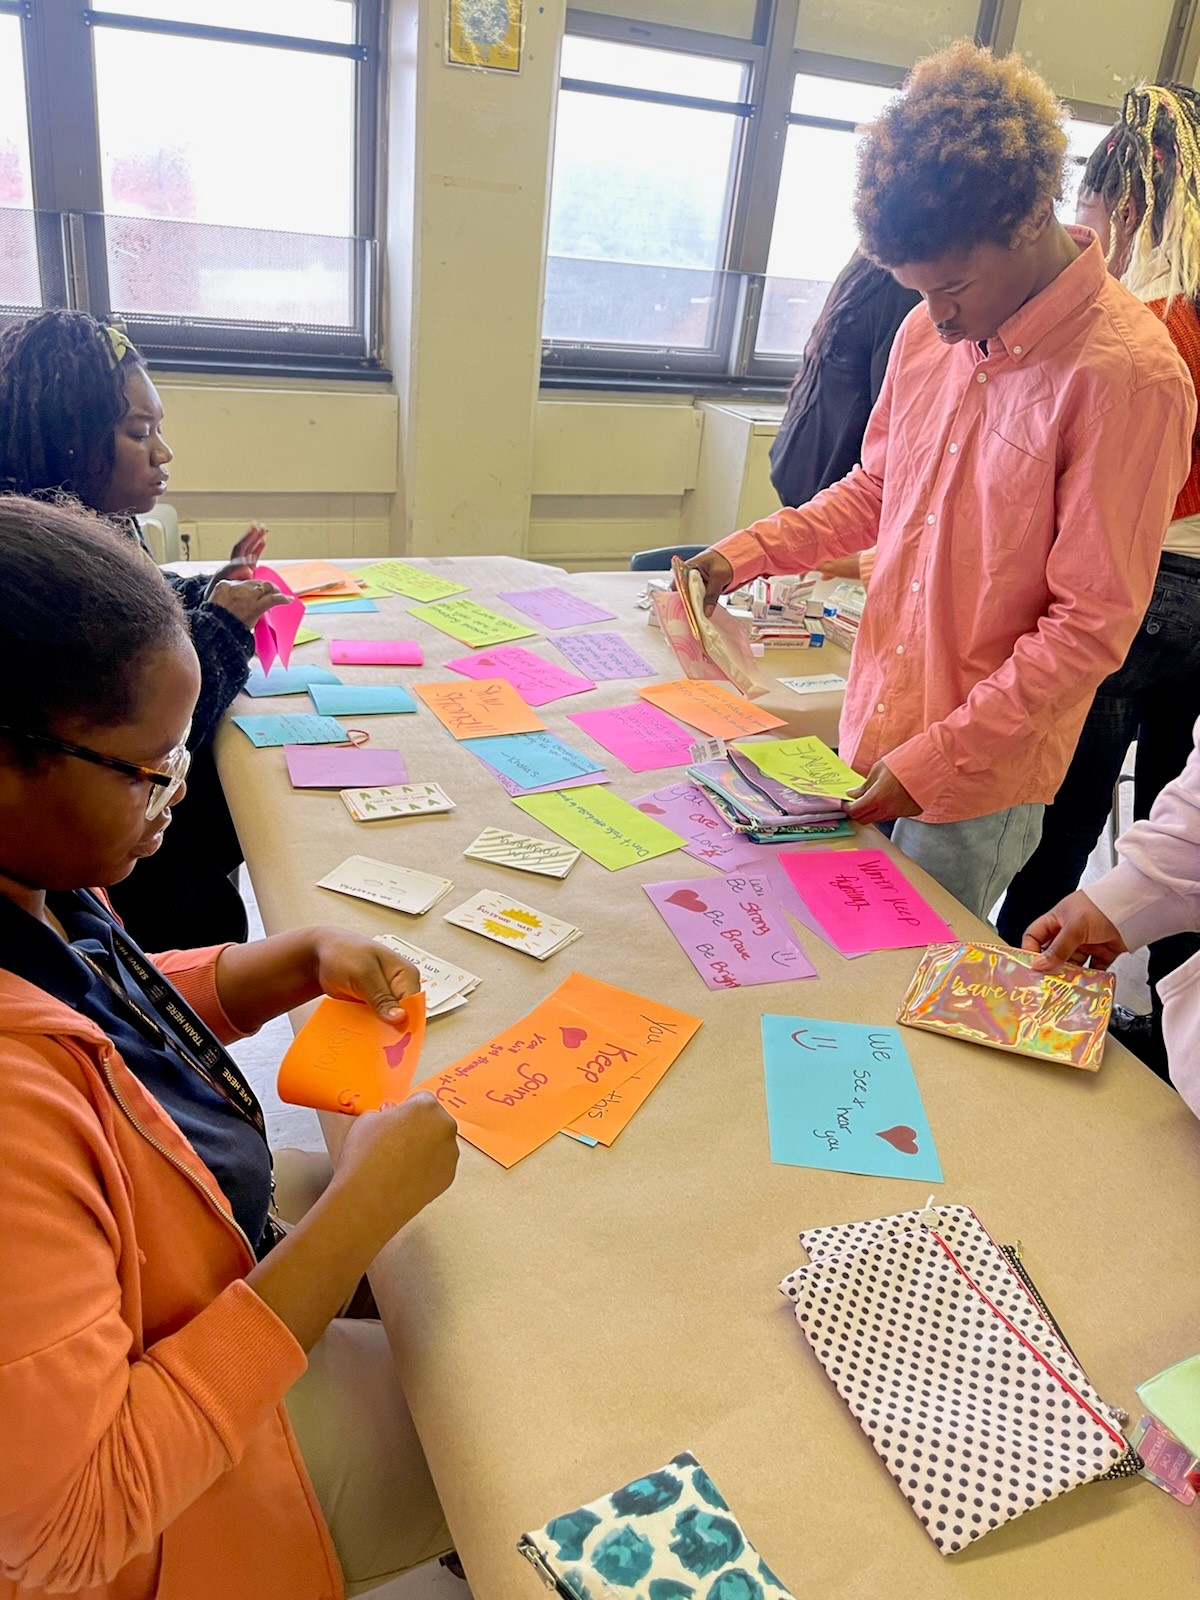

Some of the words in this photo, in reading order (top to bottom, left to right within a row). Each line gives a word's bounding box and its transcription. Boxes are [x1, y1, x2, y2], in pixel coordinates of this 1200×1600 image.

[689, 813, 719, 829] are
[726, 878, 746, 894] Be
[739, 902, 771, 936] Strong
[703, 910, 724, 927] Be
[720, 929, 751, 961] Brave
[696, 943, 715, 960] Be
[424, 964, 440, 974] am
[181, 1018, 204, 1047] TRAIN
[640, 1014, 678, 1044] You
[868, 1033, 892, 1062] We
[439, 1074, 457, 1086] it
[485, 1062, 548, 1107] going
[239, 1088, 253, 1107] LIVE
[813, 1129, 840, 1152] you
